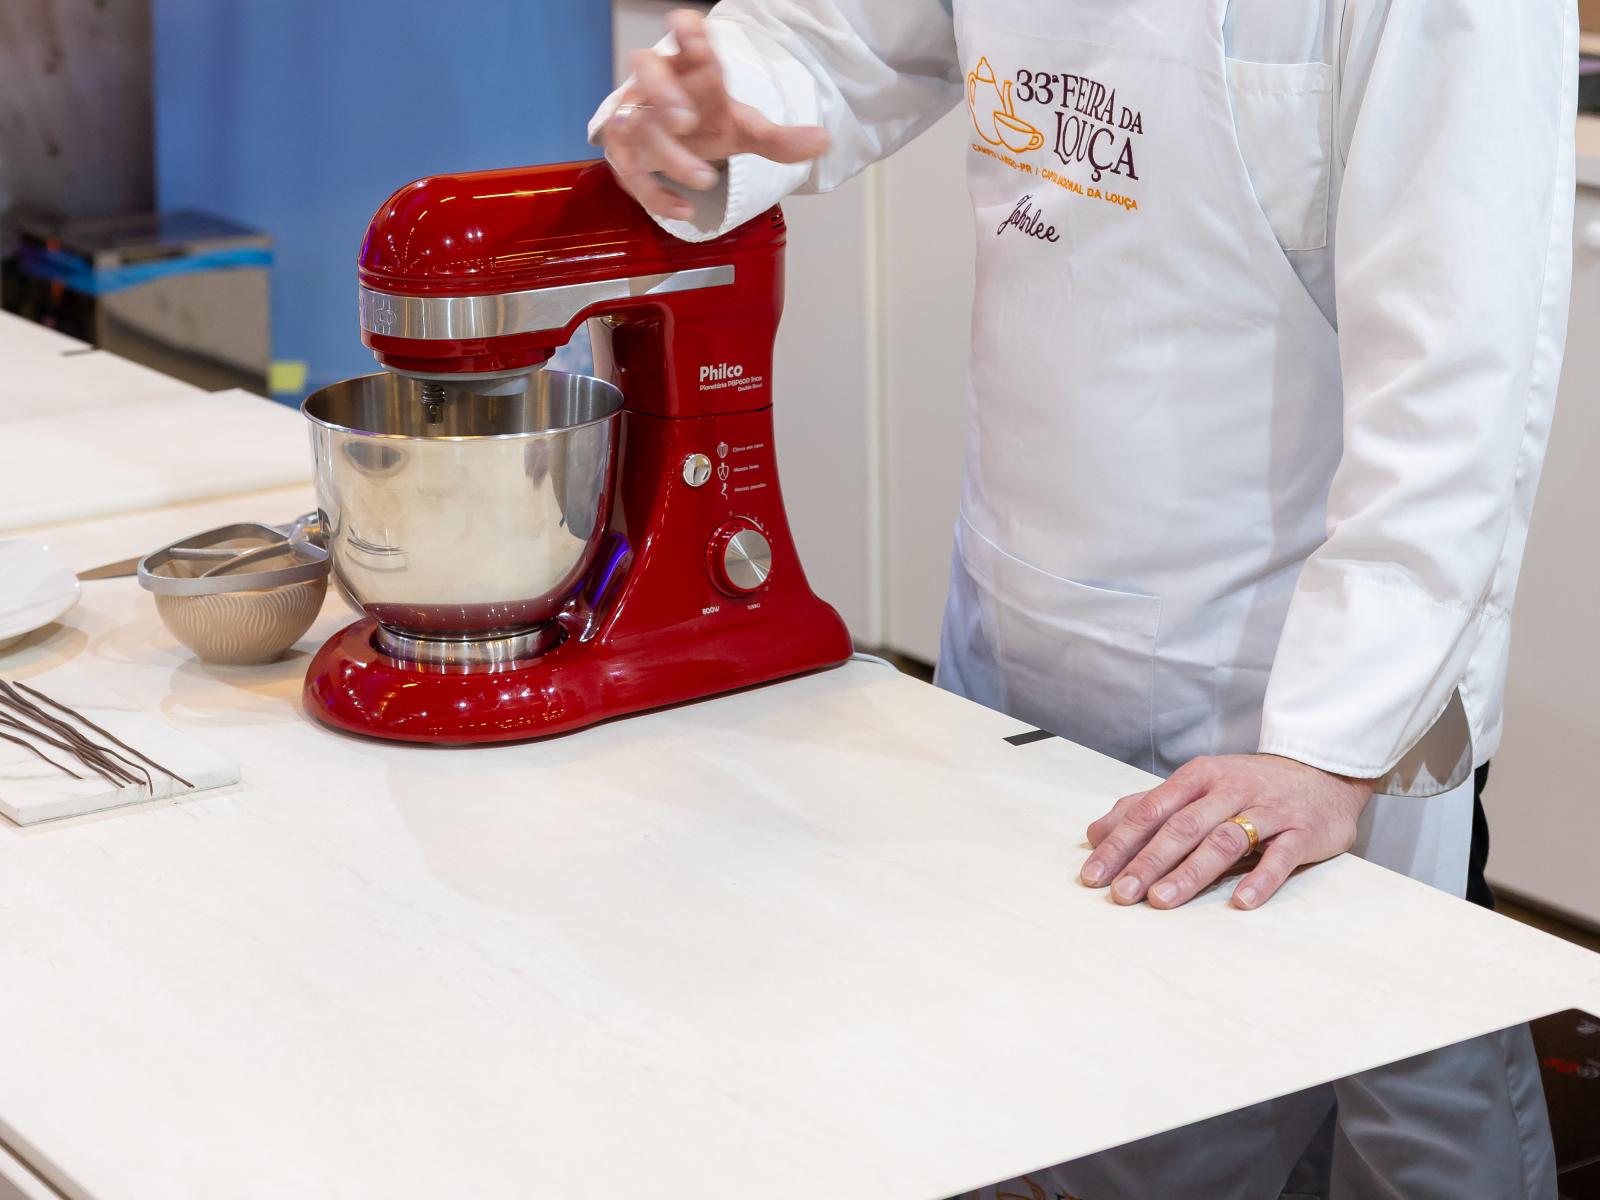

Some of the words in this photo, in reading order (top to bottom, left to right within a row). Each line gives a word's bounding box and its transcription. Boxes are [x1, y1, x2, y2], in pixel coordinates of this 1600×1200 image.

[1060, 73, 1115, 126] FEIRA
[1118, 106, 1144, 135] DA
[1054, 111, 1139, 182] LOUÇA
[1087, 187, 1103, 200] DA
[1105, 191, 1138, 210] LOUÇA
[700, 363, 743, 382] Philco
